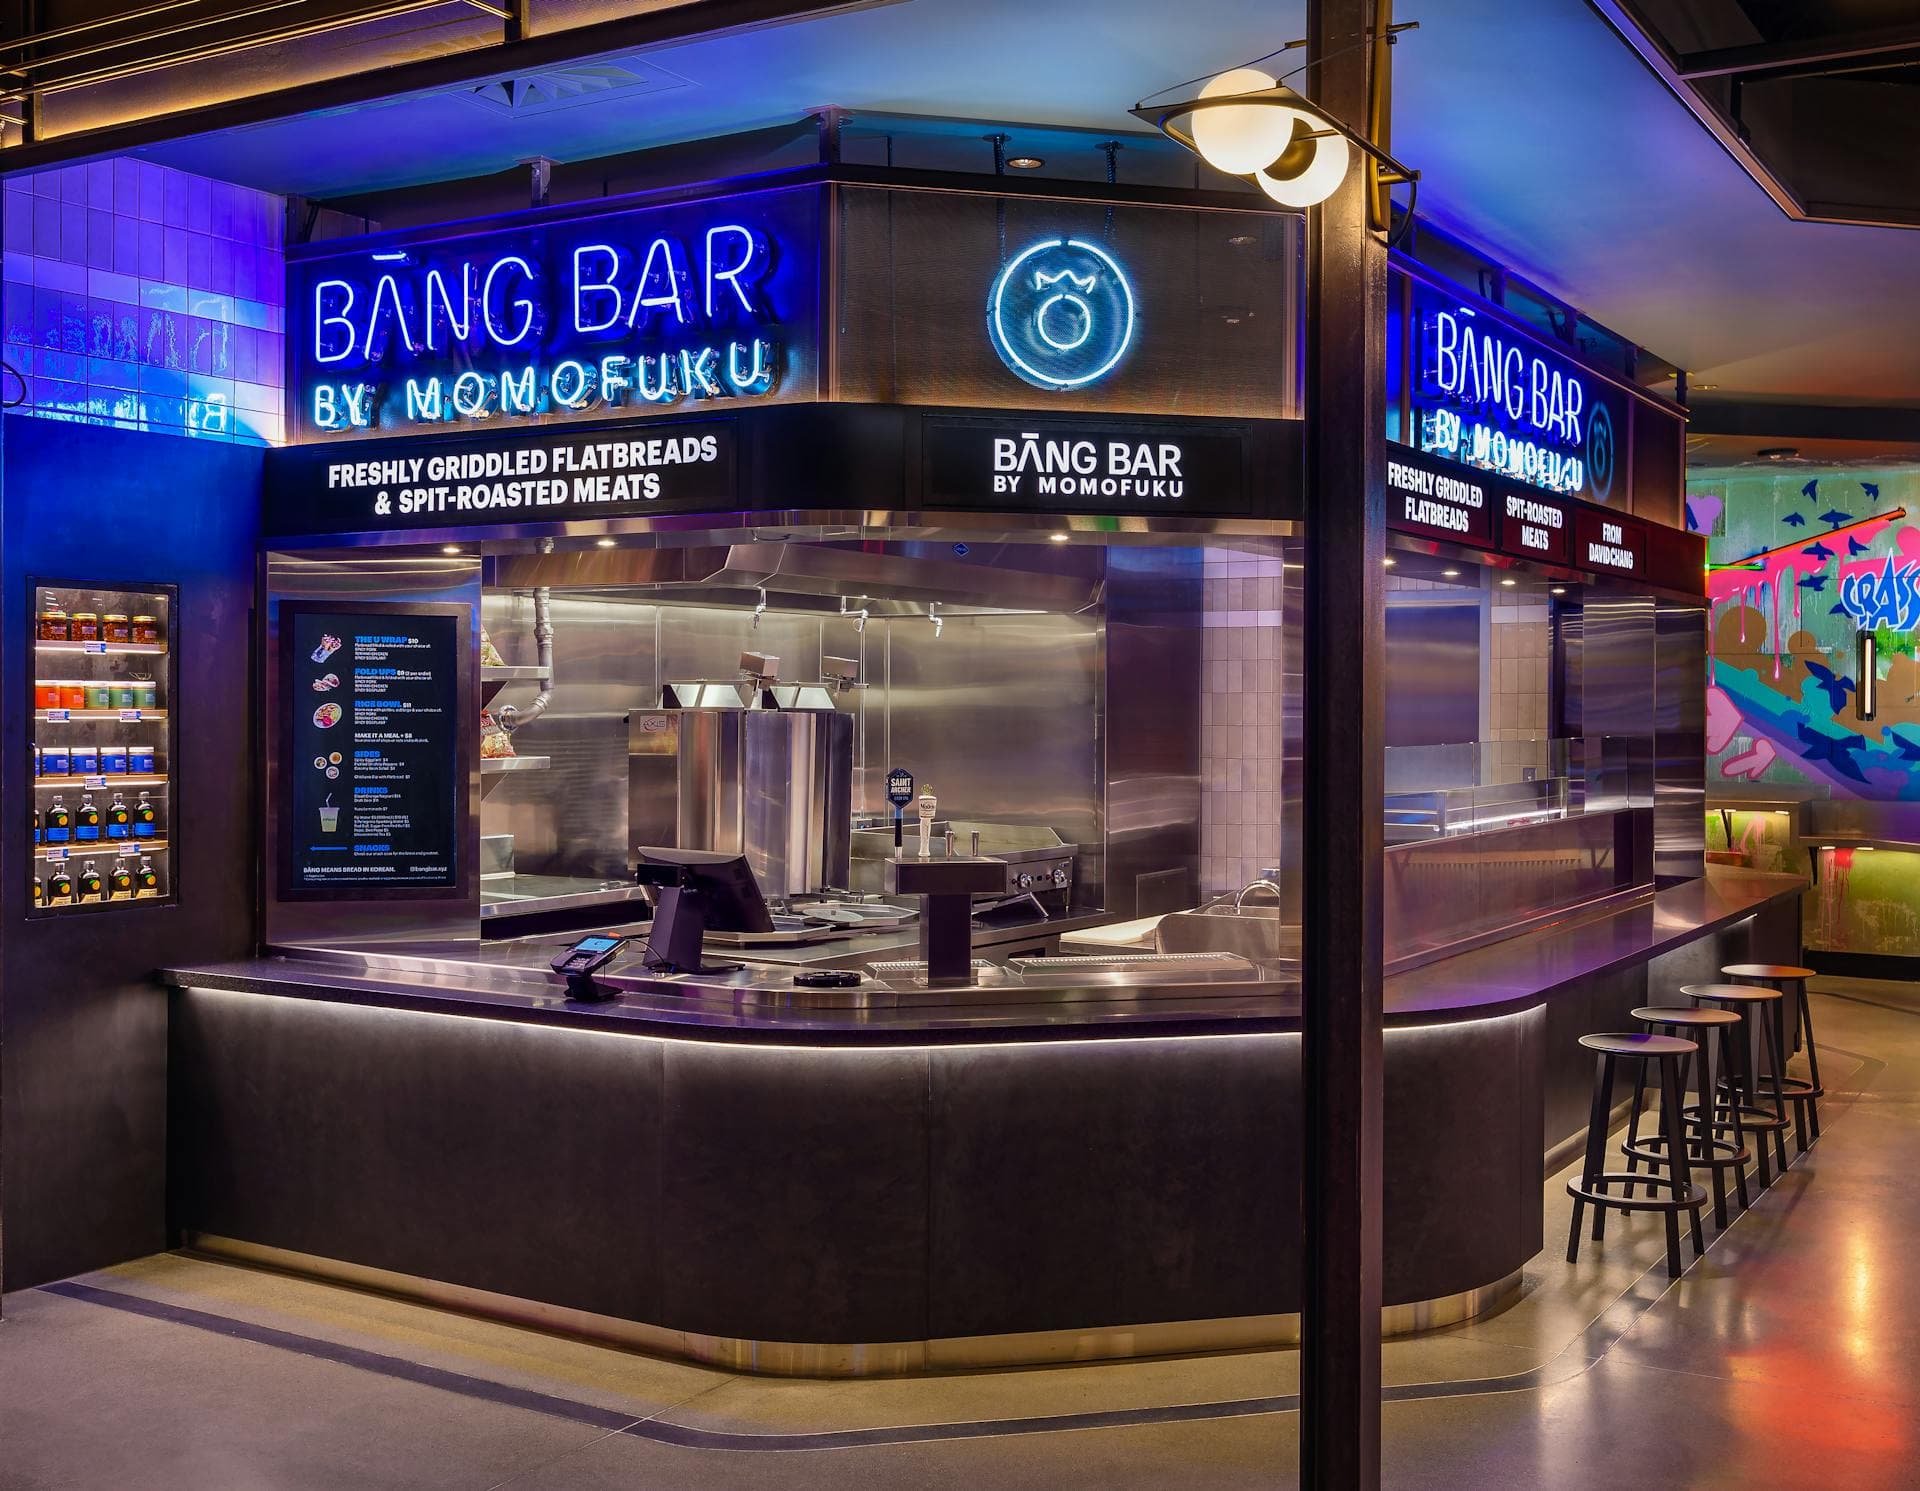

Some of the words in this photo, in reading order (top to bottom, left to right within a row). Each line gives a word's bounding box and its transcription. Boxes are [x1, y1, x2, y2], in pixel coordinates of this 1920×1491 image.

[315, 254, 534, 363] BĀNG
[573, 224, 754, 333] BAR
[313, 383, 365, 427] BY
[405, 337, 767, 420] MOMOFUKU
[1437, 307, 1524, 420] BĀNG
[1532, 358, 1583, 445] BAR
[1434, 408, 1461, 452] BY
[328, 457, 424, 488] FRESHLY
[427, 448, 542, 481] GRIDDLED
[553, 435, 718, 474] FLATBREADS
[994, 432, 1097, 475] BĀNG
[1108, 443, 1182, 477] BAR
[374, 492, 392, 514] &
[399, 479, 569, 514] SPIT-ROASTED
[573, 473, 660, 504] MEATS
[994, 475, 1021, 493] BY
[1038, 476, 1184, 497] MOMOFUKU
[1387, 461, 1434, 495] FRESHLY
[1435, 474, 1483, 508] GRIDDLED
[1404, 496, 1469, 533] FLATBREADS
[1506, 496, 1563, 529] SPIT-ROASTED
[1522, 525, 1548, 550] MEATS
[1602, 523, 1622, 544] FROM
[1588, 542, 1610, 564] DAVID
[1610, 548, 1633, 570] CHANG
[891, 778, 912, 786] SAINT
